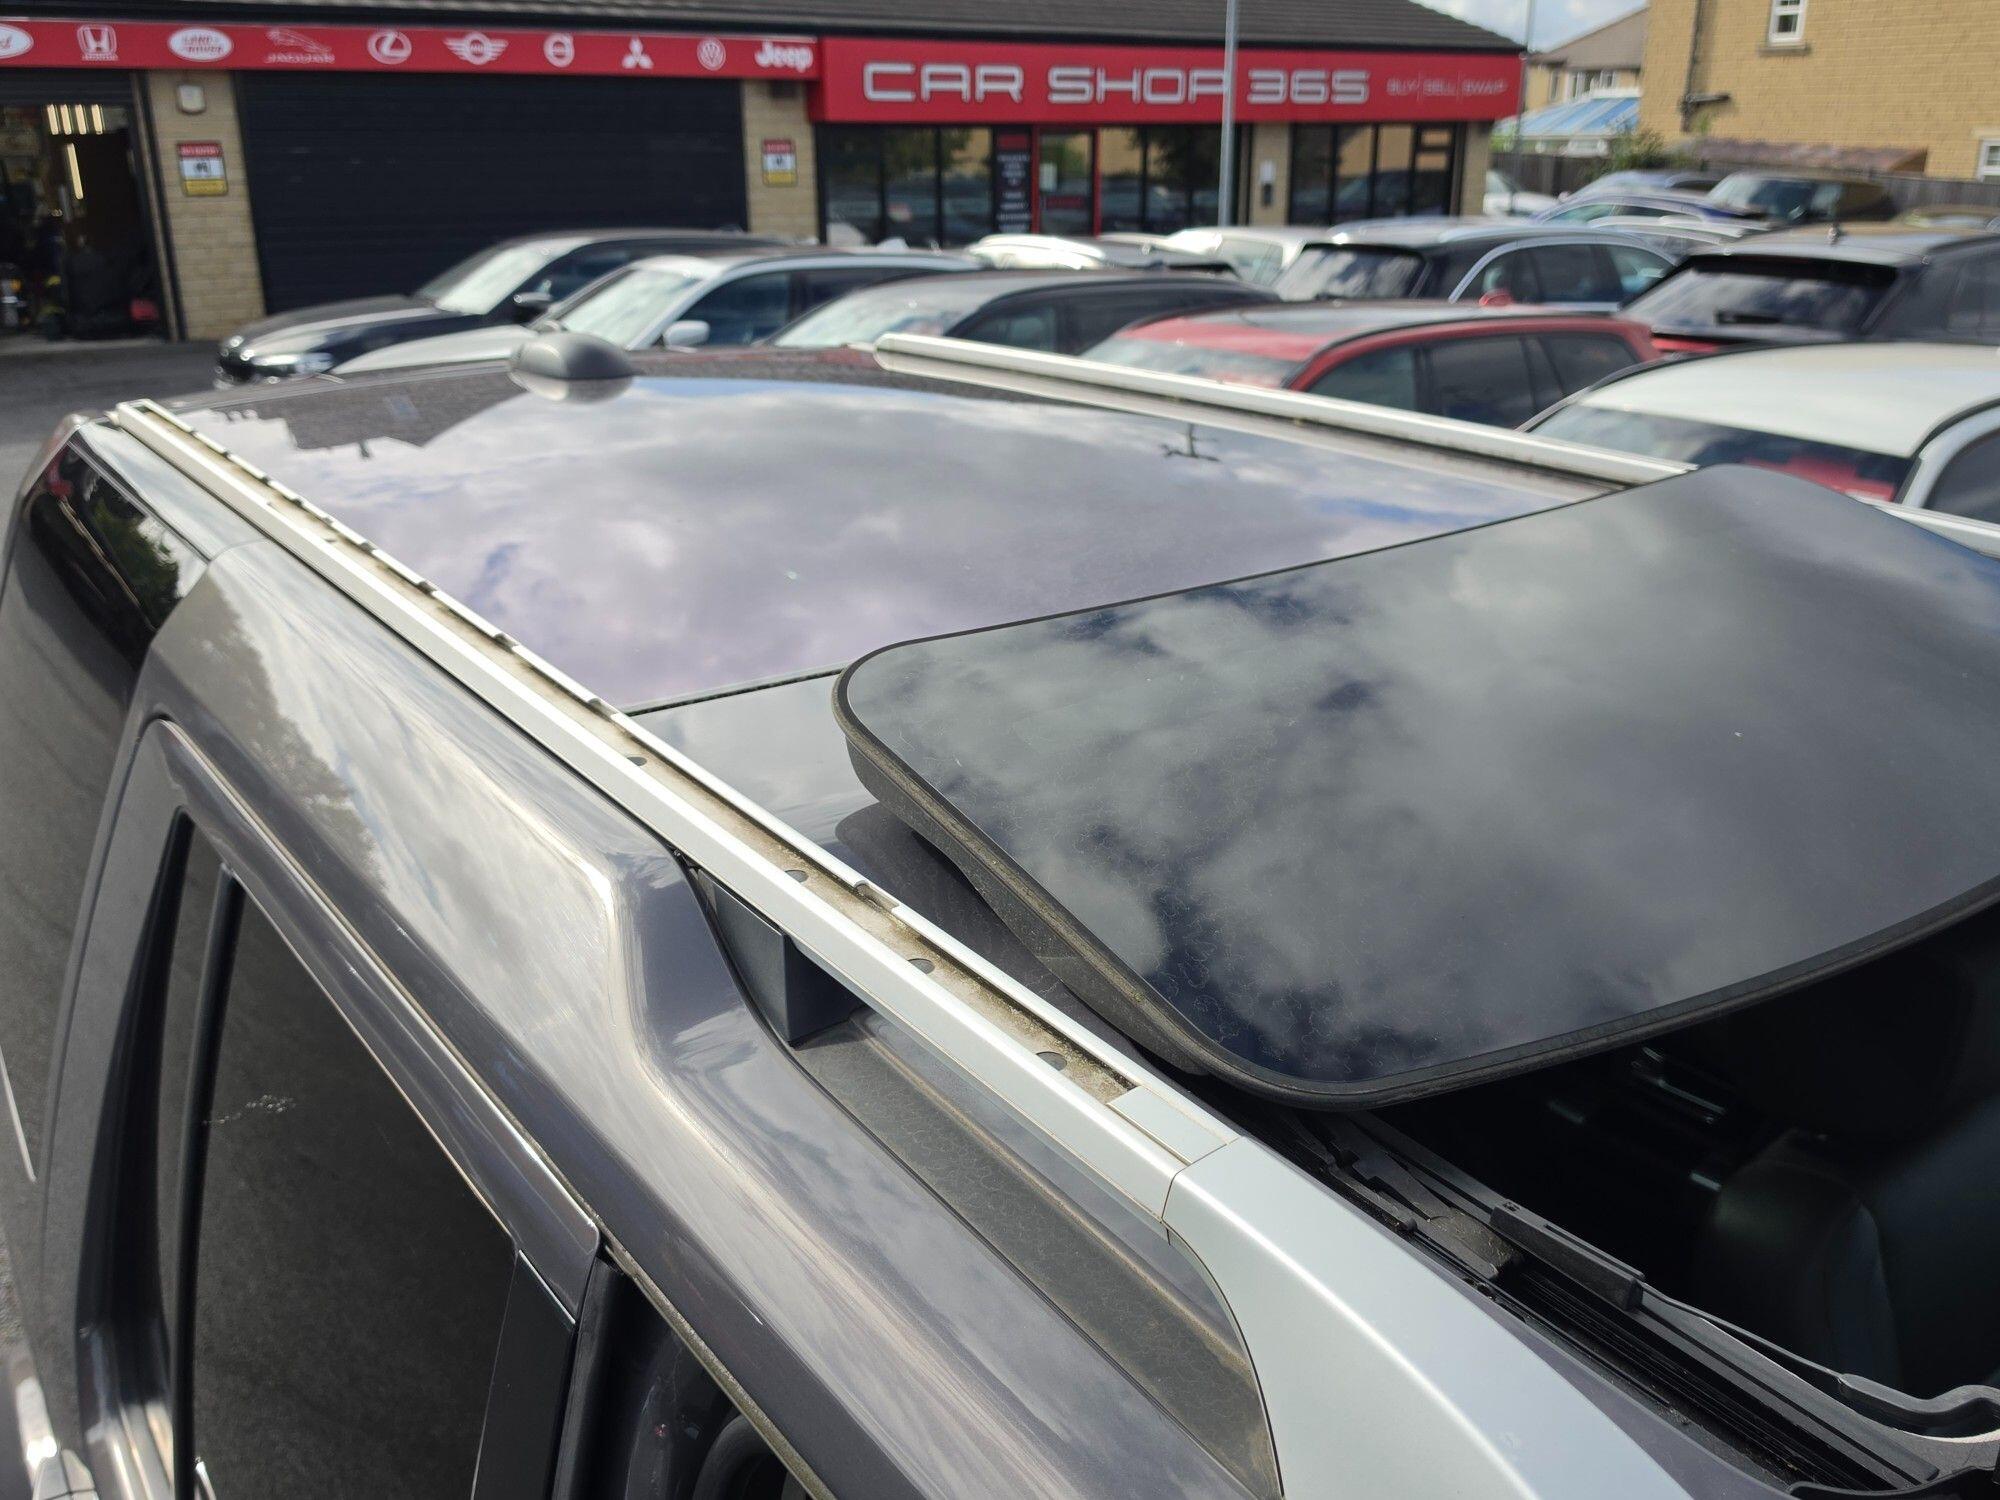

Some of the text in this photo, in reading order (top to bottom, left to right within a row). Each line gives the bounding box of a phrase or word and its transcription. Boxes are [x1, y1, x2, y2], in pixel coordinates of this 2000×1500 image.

[264, 52, 335, 64] JAGUAR
[754, 40, 813, 73] Jeep
[863, 62, 1369, 104] CAR SHOP 365
[1386, 78, 1508, 97] BUY SELL SWAP
